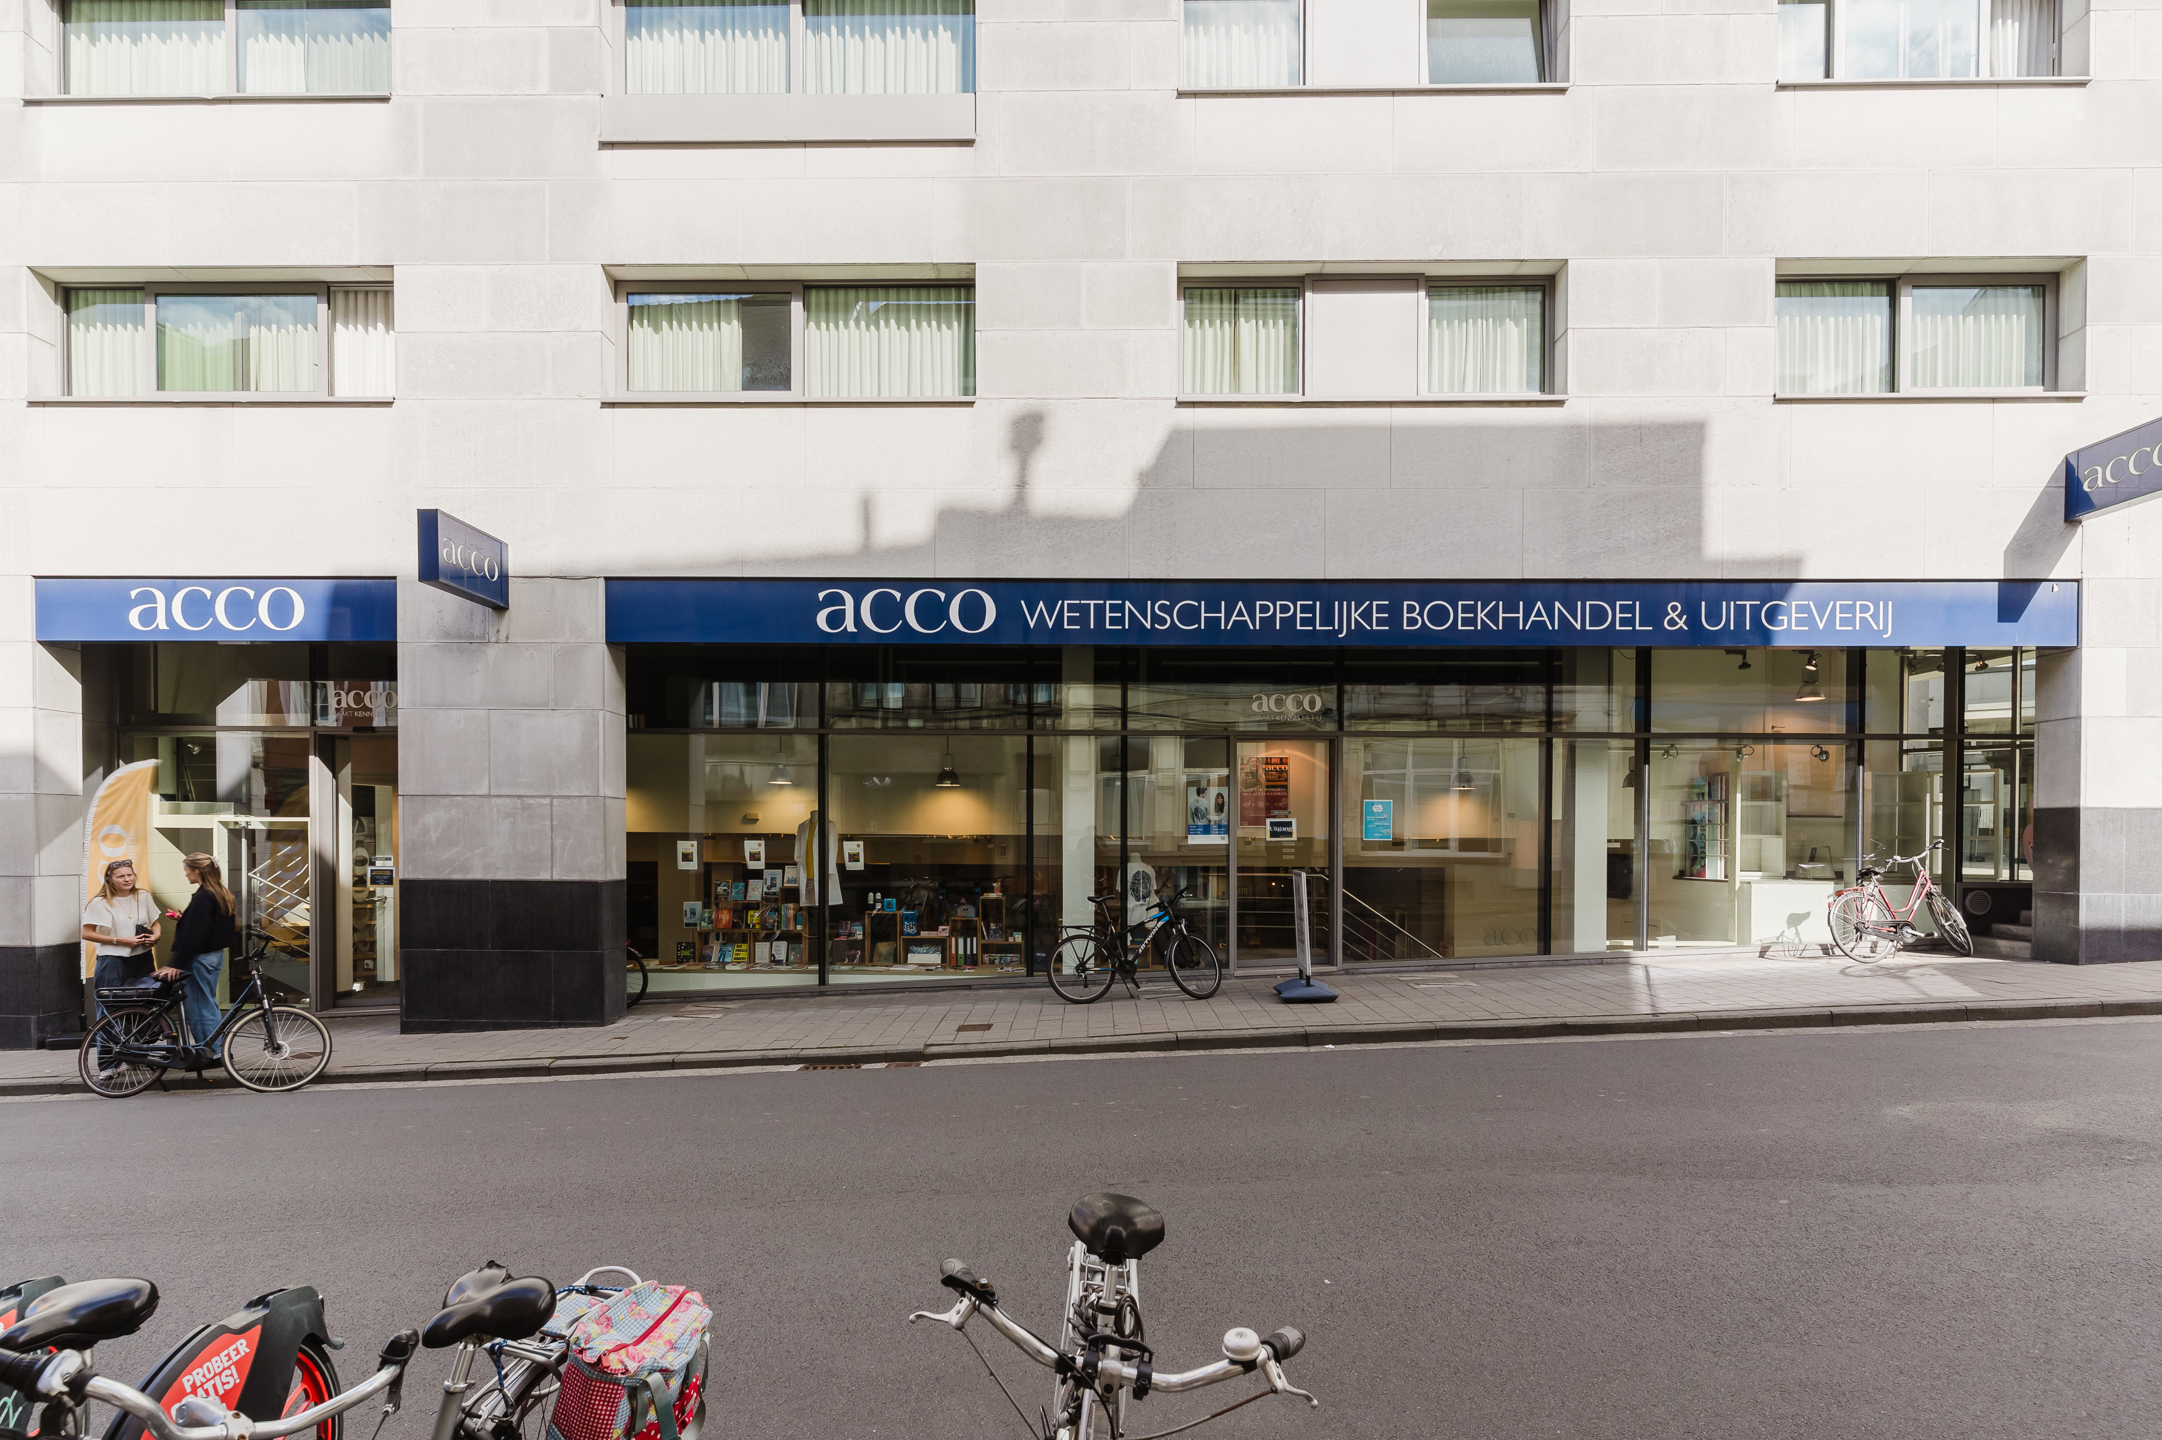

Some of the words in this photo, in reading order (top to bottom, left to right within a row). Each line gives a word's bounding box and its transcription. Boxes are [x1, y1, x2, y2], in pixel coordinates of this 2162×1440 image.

[443, 537, 499, 582] acco
[129, 586, 305, 631] acco
[816, 588, 997, 634] acco
[1021, 600, 1390, 638] WETENSCHAPPELIJKE
[1402, 600, 1654, 631] BOEKHANDEL
[1663, 601, 1689, 631] &
[1700, 601, 1894, 638] UITGEVERIJ
[333, 689, 398, 709] acco
[1251, 693, 1322, 713] acco
[181, 1338, 251, 1394] PROBEER
[170, 1364, 241, 1422] ATIS!
